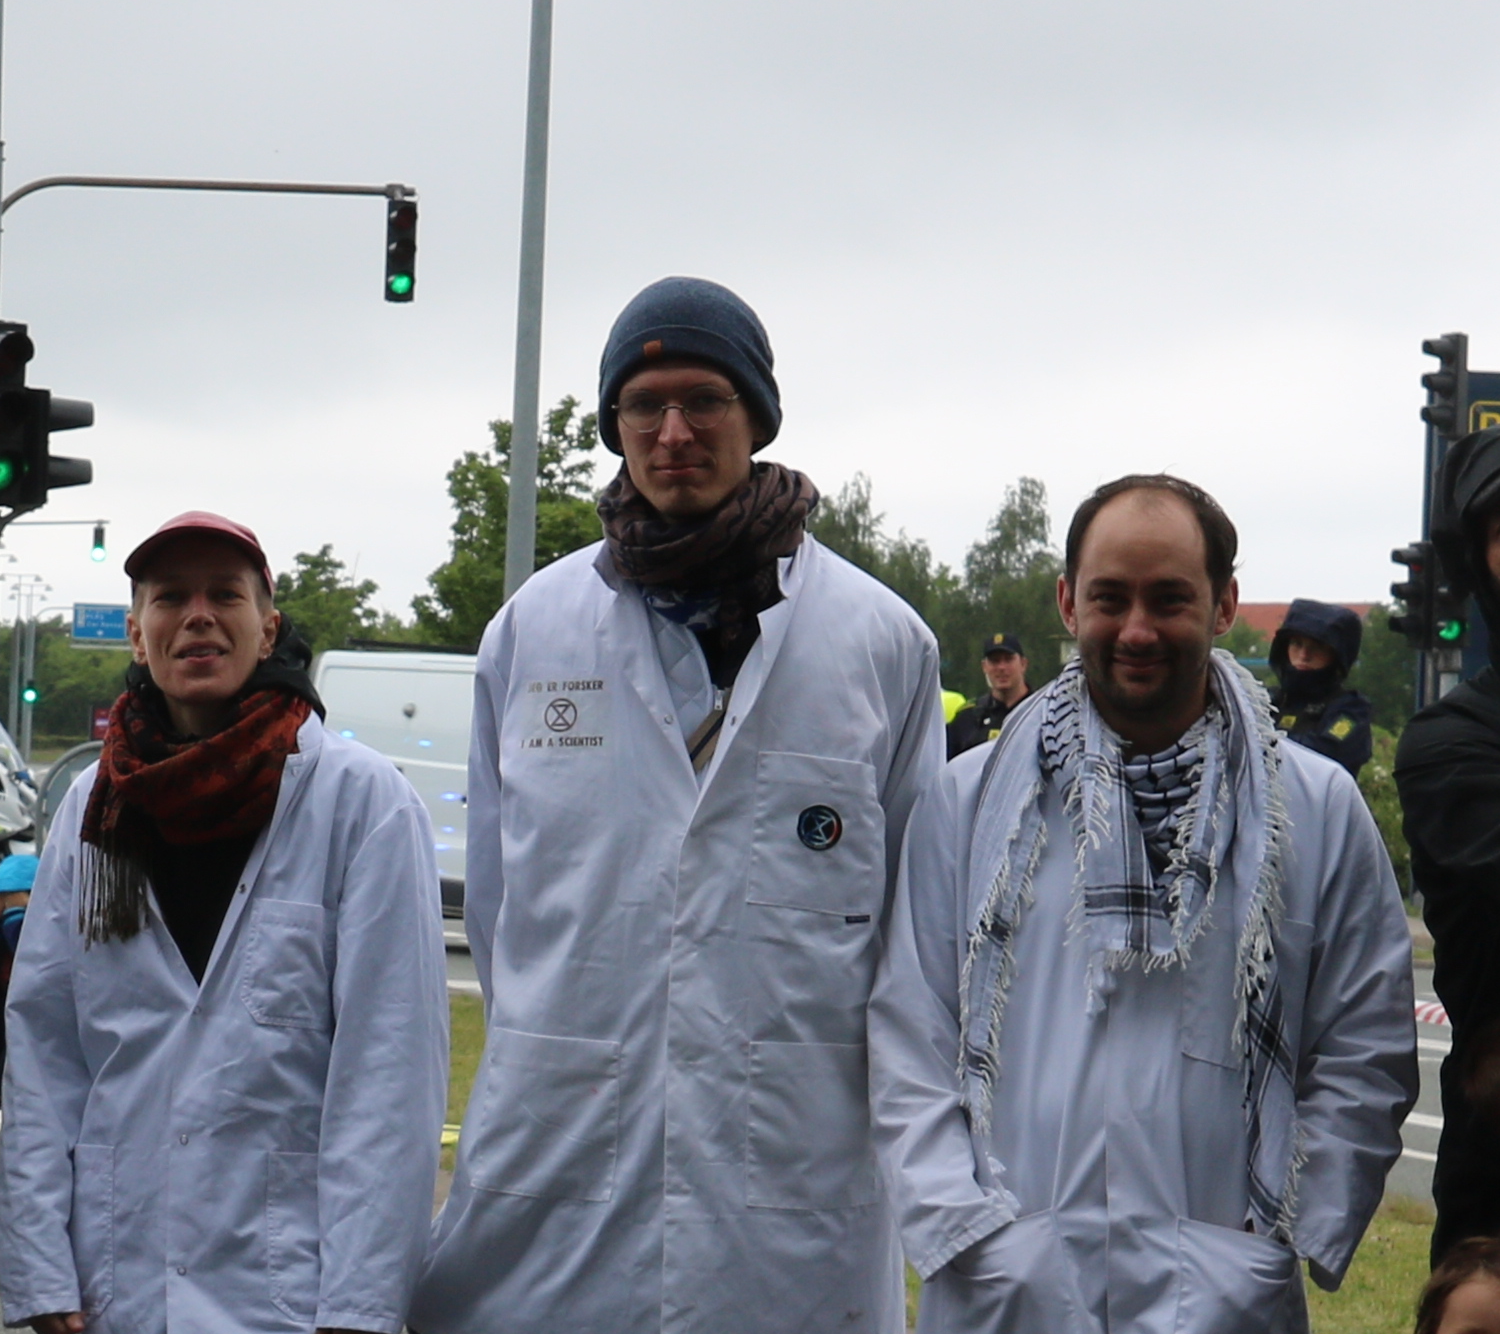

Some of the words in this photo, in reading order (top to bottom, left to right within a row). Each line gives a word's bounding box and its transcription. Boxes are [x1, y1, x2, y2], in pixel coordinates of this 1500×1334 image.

[547, 681, 558, 693] ER
[562, 679, 604, 692] FORSKER
[529, 737, 543, 749] AM
[547, 737, 555, 748] A
[559, 735, 604, 748] SCIENTIST
